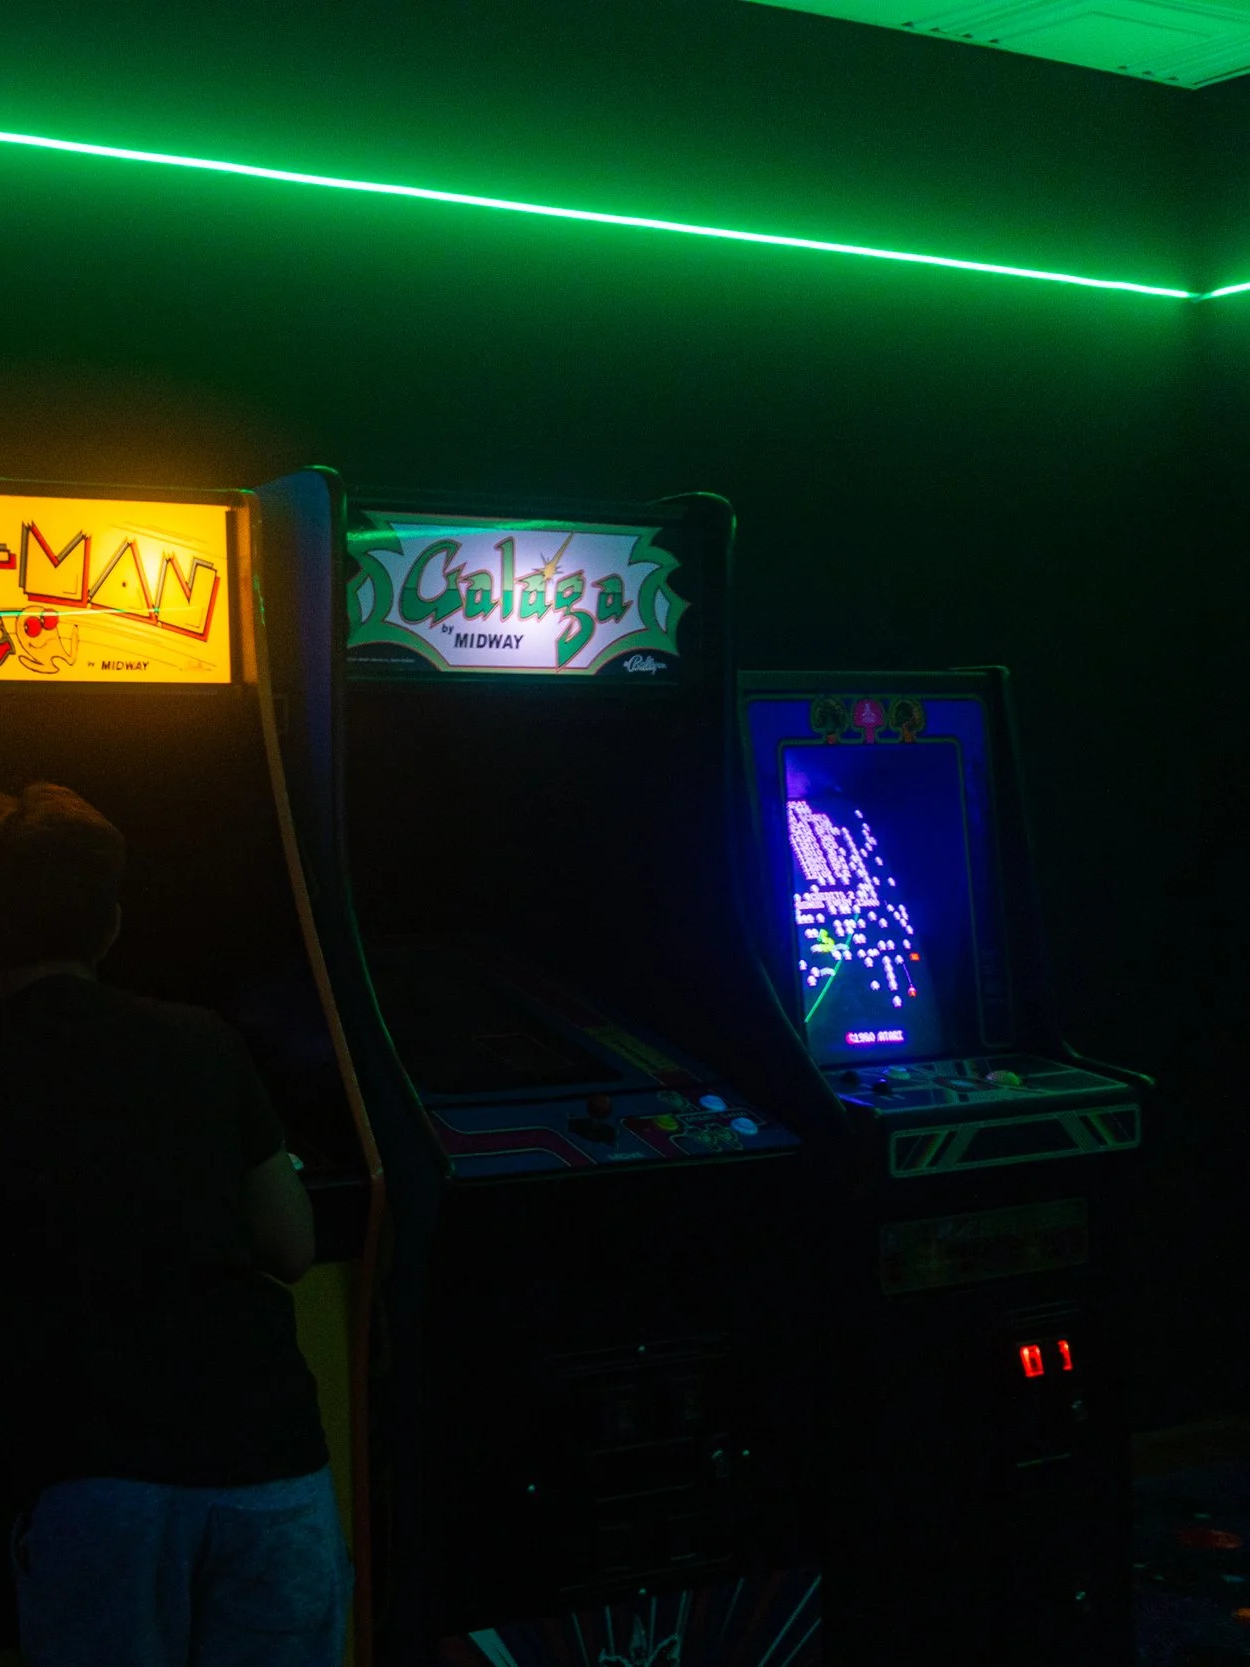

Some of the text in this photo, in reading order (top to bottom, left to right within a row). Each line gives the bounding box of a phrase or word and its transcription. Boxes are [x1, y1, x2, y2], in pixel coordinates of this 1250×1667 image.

[399, 535, 633, 672] Galaga
[441, 623, 454, 635] by
[453, 632, 524, 649] MIDWAY
[101, 660, 149, 671] MIDWAY
